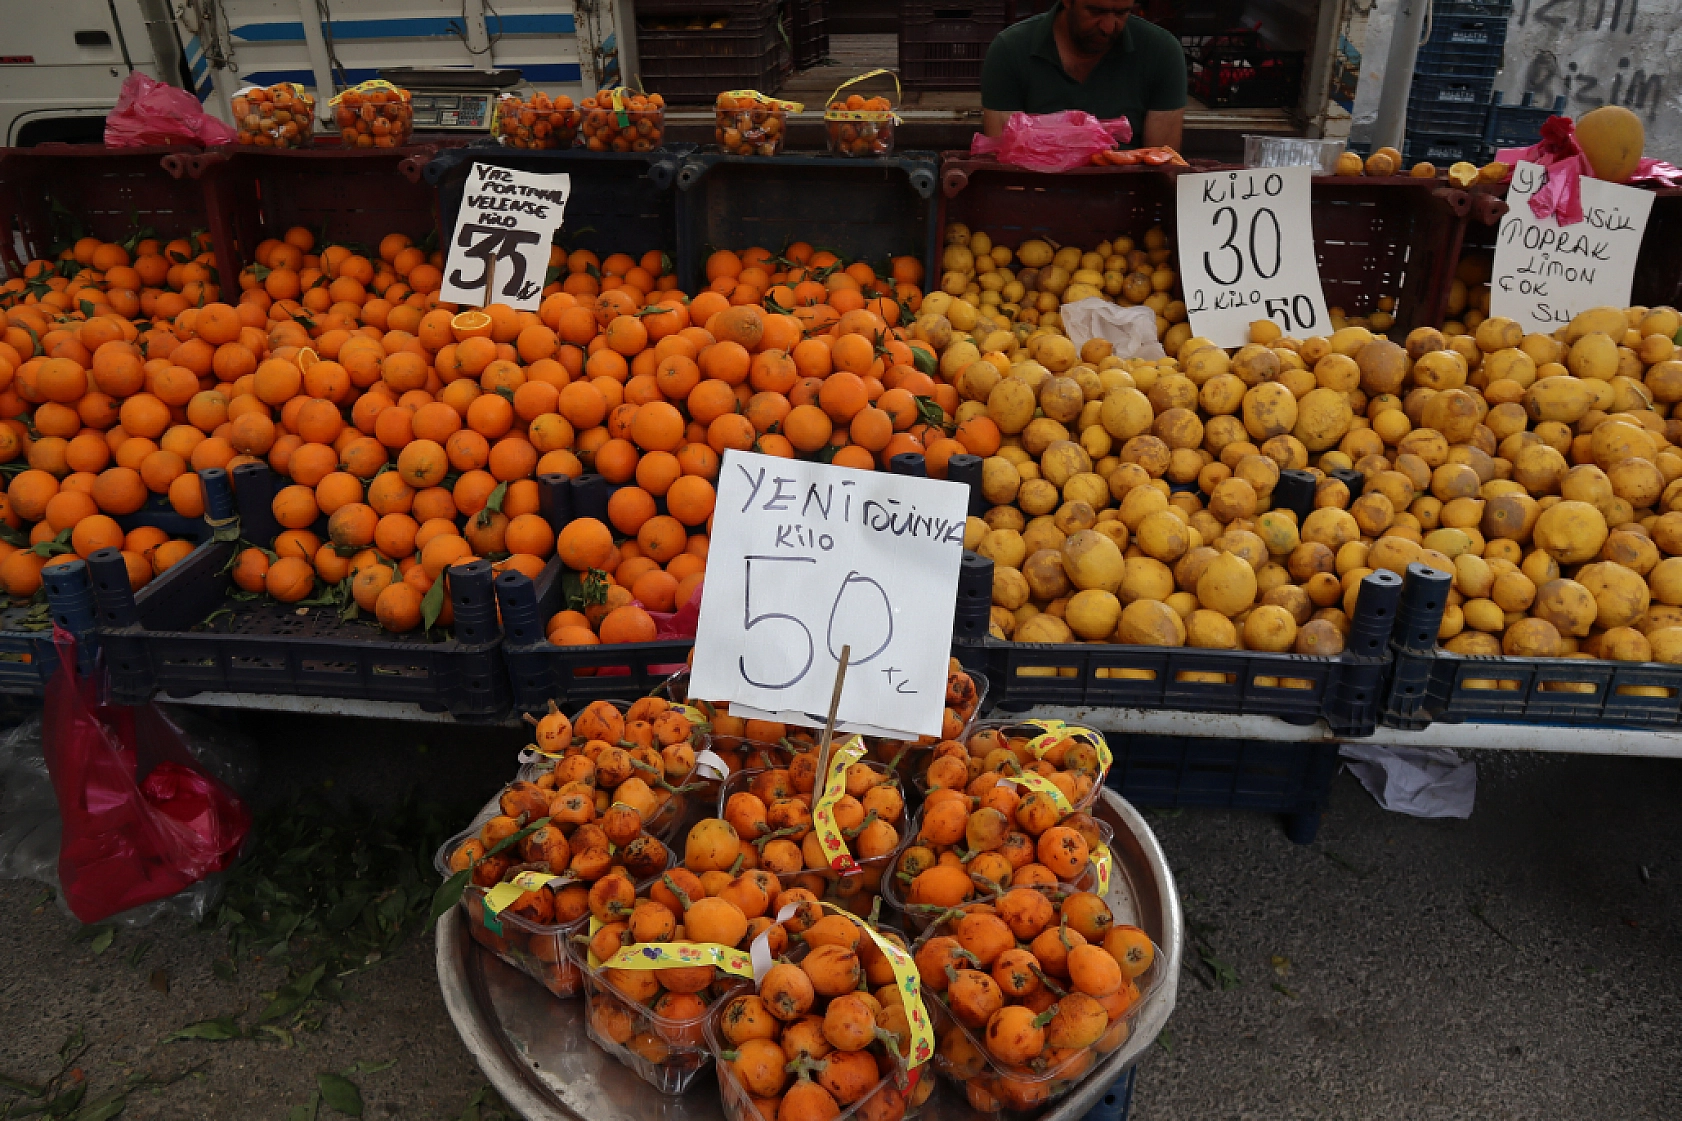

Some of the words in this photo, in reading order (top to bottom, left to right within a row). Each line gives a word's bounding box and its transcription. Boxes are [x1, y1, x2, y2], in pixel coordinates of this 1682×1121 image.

[477, 165, 513, 182] YAZ
[1203, 206, 1281, 285] 30
[1501, 217, 1611, 260] TOPRAK
[449, 224, 541, 296] 35
[1499, 276, 1549, 296] ÇOK
[1188, 289, 1208, 314] 2
[1265, 294, 1316, 331] 50
[1532, 303, 1572, 322] SU
[739, 555, 894, 689] 50
